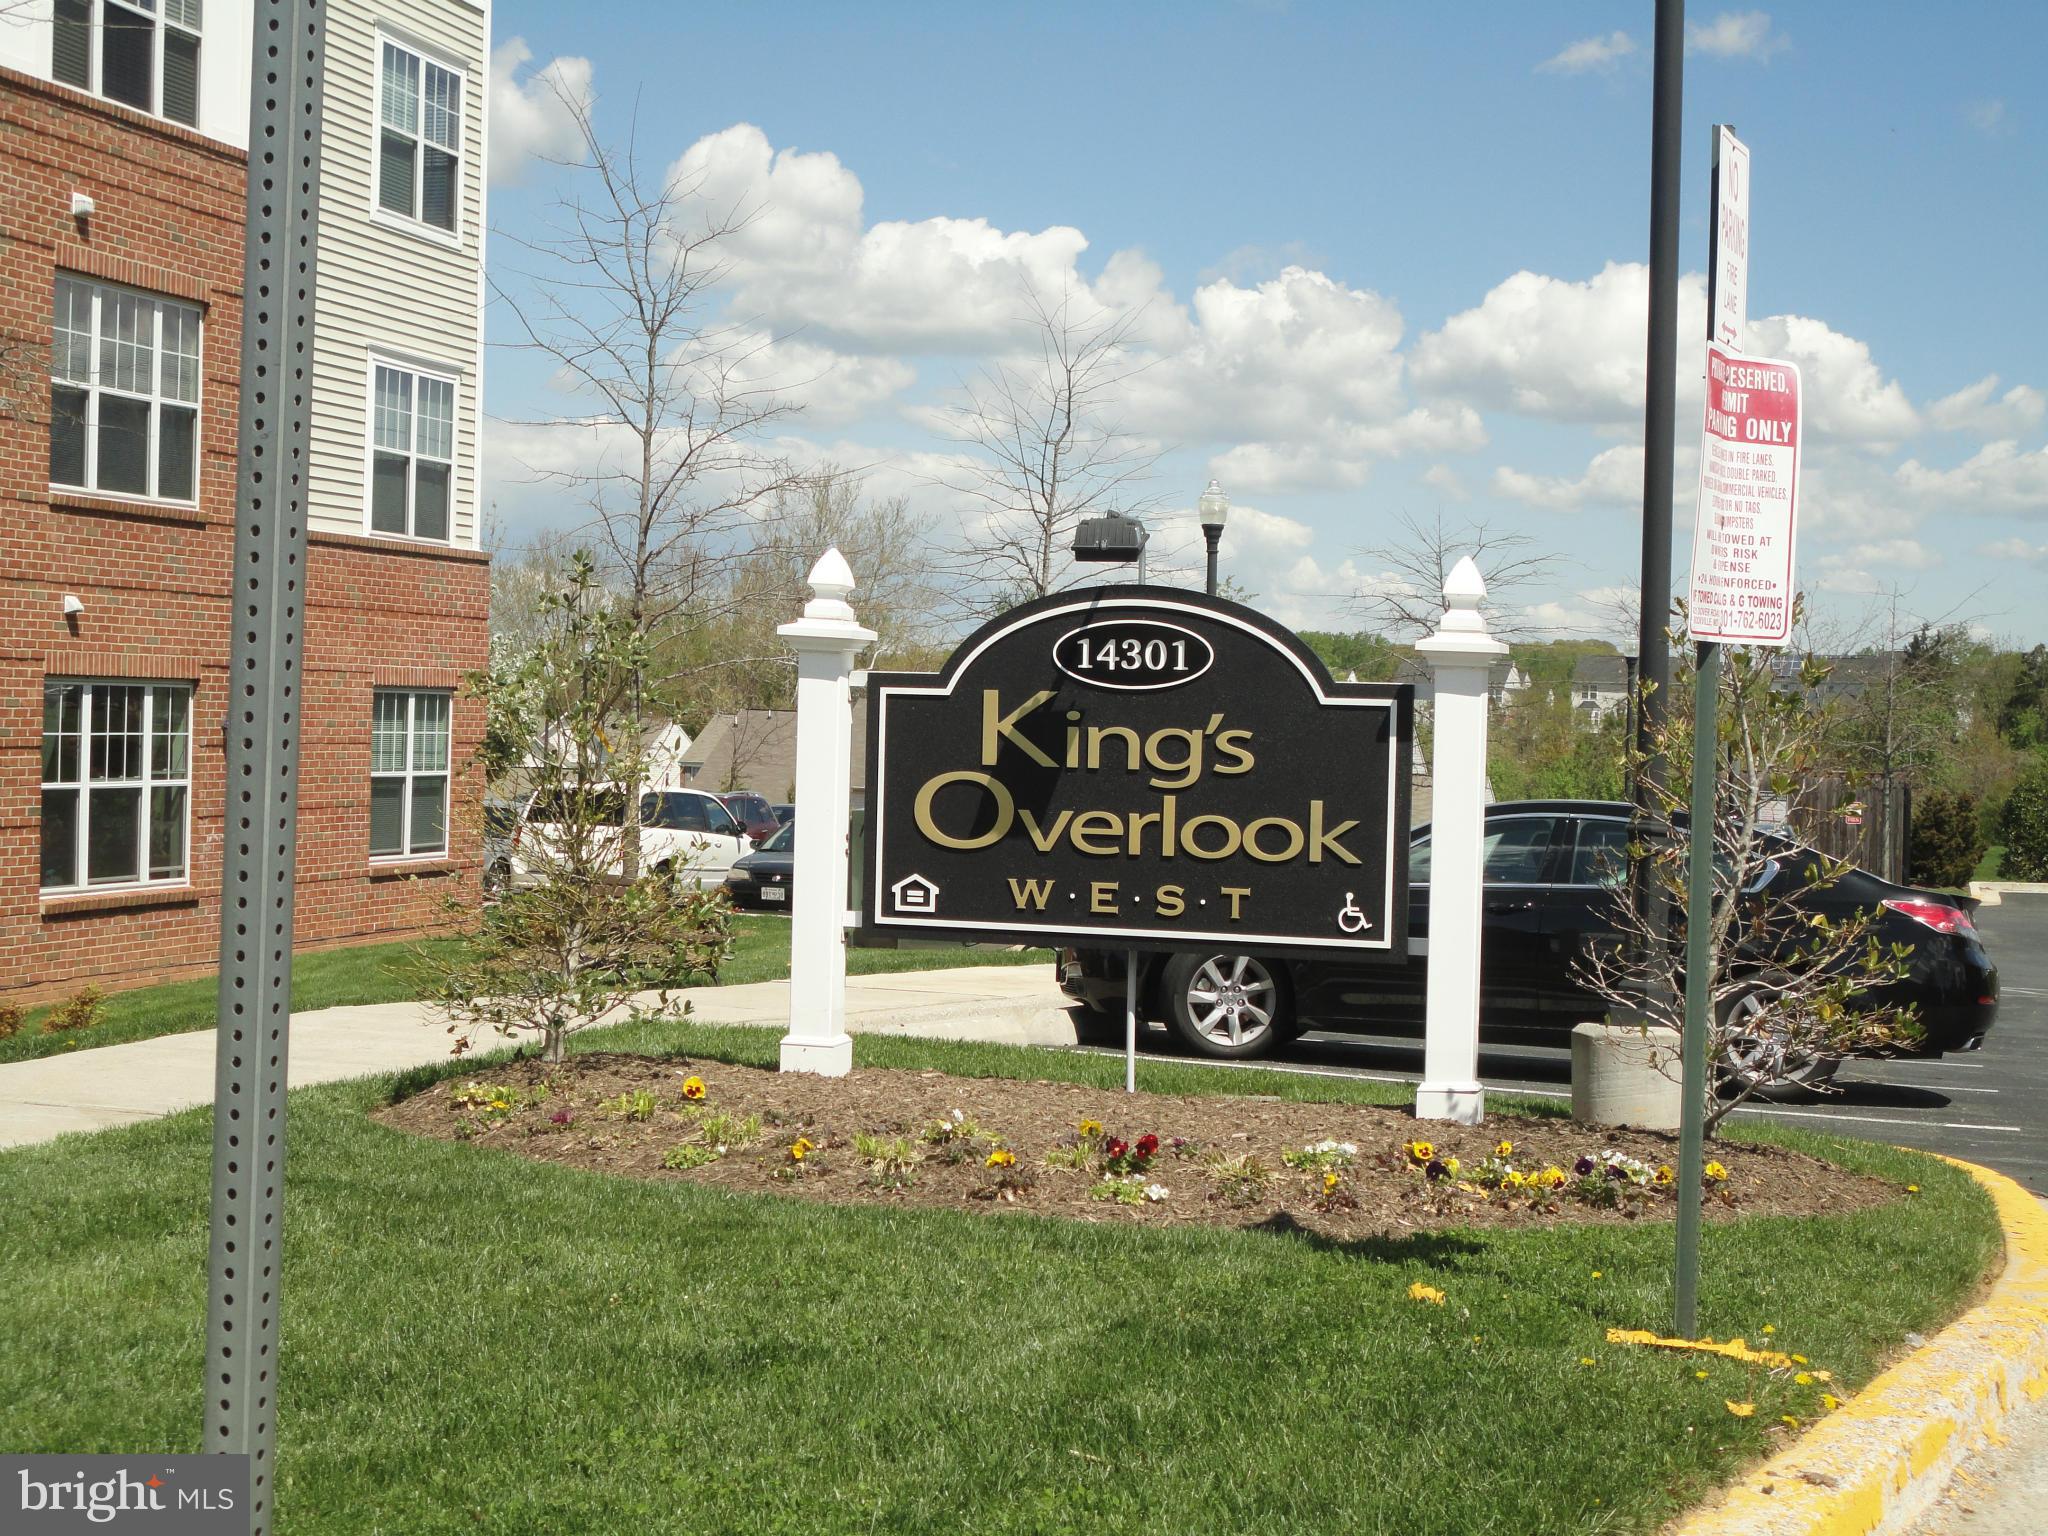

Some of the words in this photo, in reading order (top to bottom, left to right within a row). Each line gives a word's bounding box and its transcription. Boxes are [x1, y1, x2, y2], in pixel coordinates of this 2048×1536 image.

[1728, 157, 1739, 202] NO
[1722, 203, 1745, 259] PARKING
[1726, 261, 1738, 286] FIRE
[1723, 293, 1738, 315] LANE
[1745, 418, 1792, 443] ONLY
[1736, 451, 1750, 465] FIRE
[1726, 467, 1750, 481] DOUBLE
[1733, 548, 1758, 560] RISK
[1760, 536, 1772, 547] AT
[1730, 594, 1735, 606] &
[1739, 595, 1745, 607] G
[1748, 595, 1783, 609] TOWING
[1077, 638, 1189, 671] 14301
[982, 689, 1255, 788] King's
[914, 771, 1362, 865] Overlook
